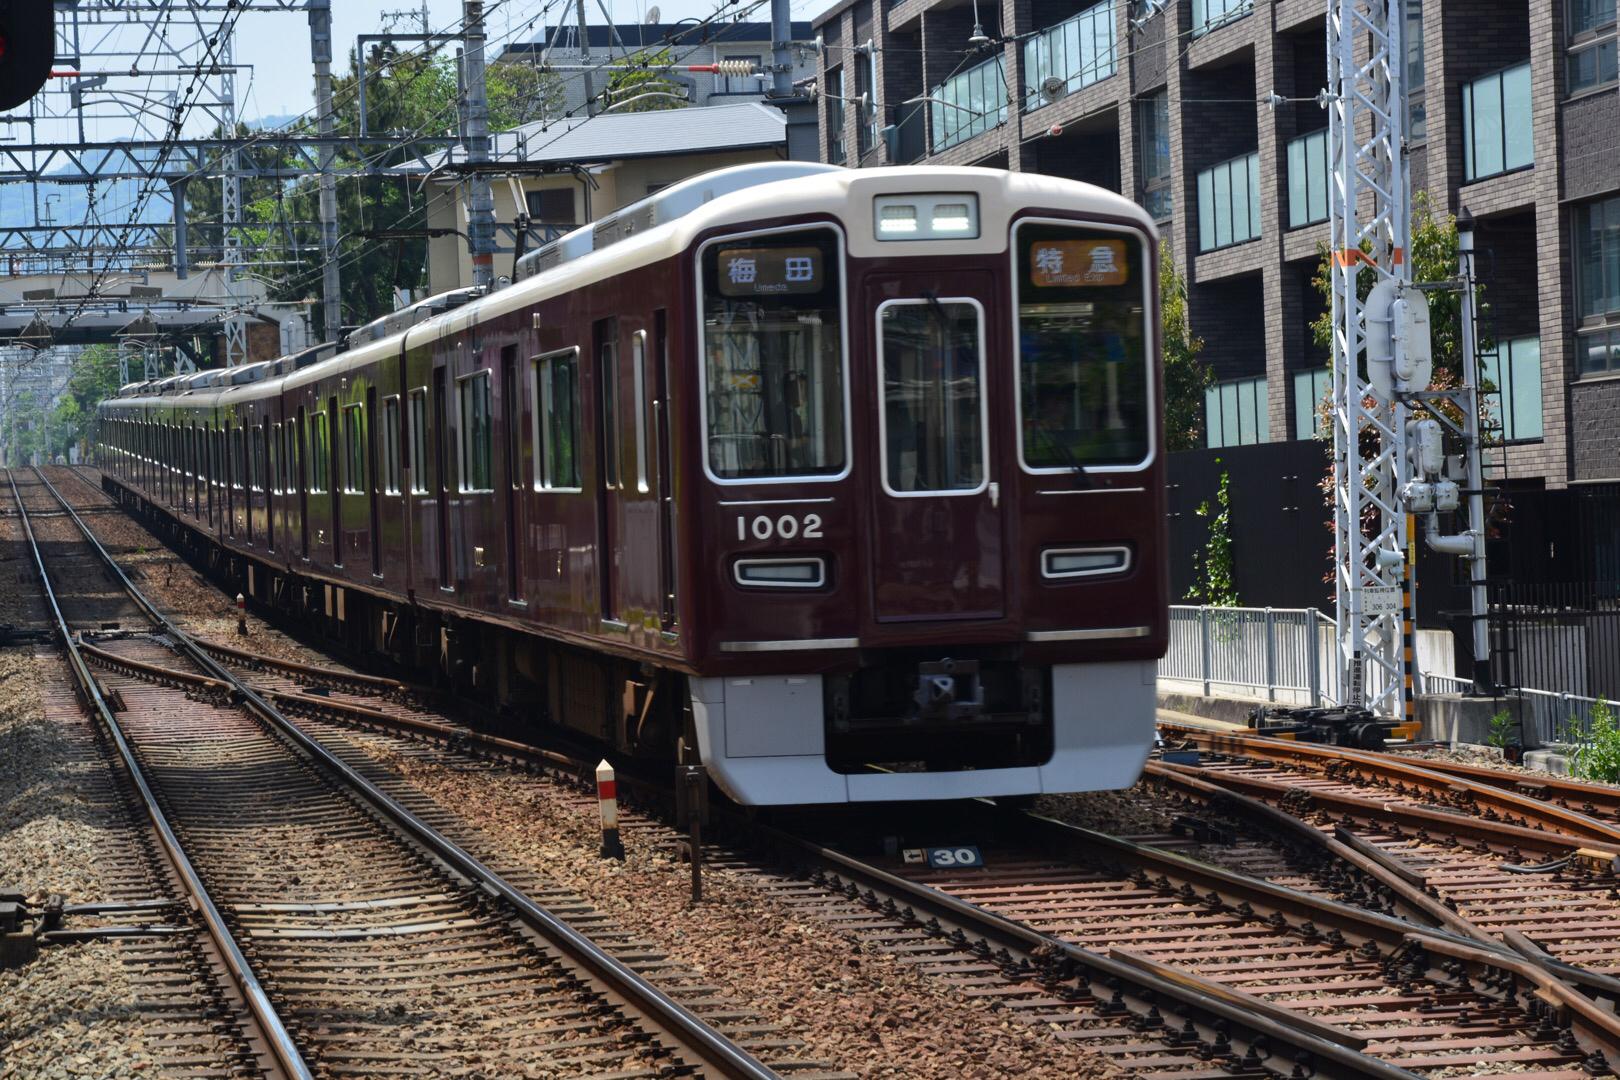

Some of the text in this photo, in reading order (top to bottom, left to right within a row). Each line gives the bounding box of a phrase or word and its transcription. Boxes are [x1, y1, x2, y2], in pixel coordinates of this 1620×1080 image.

[728, 258, 814, 283] 梅田
[1036, 246, 1118, 274] 特急
[737, 513, 823, 541] 1002
[934, 848, 976, 865] 30
